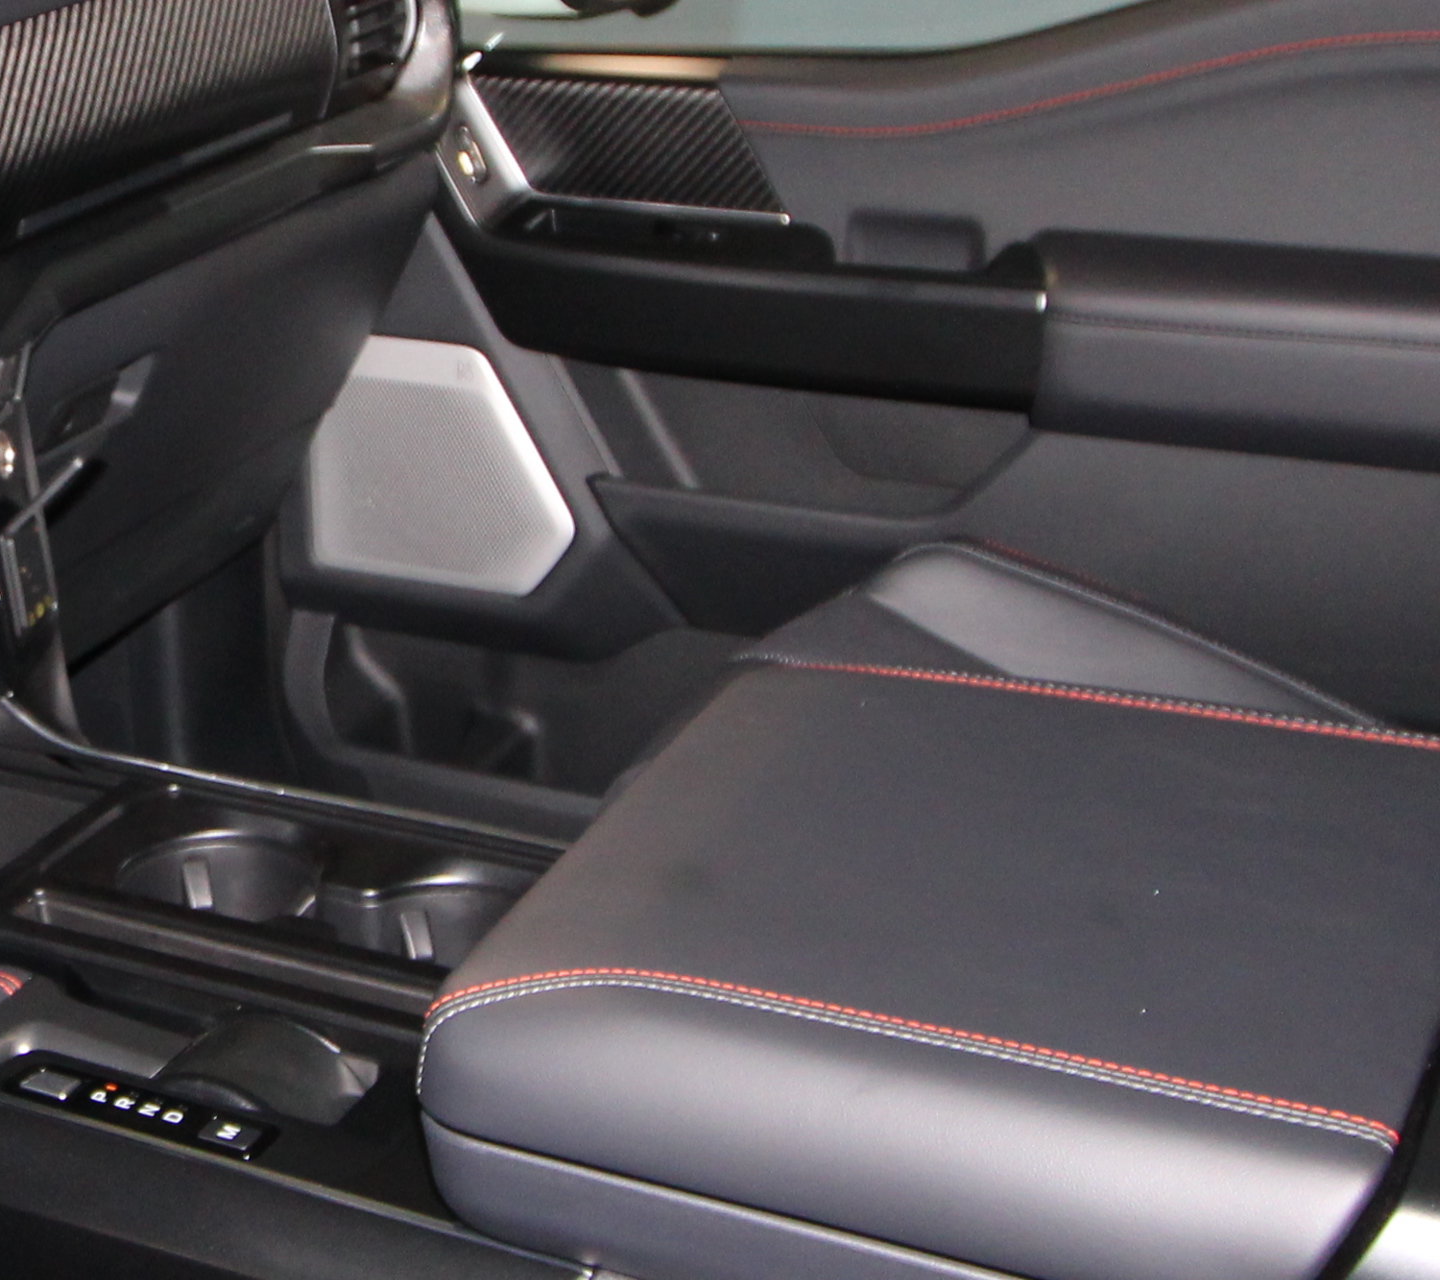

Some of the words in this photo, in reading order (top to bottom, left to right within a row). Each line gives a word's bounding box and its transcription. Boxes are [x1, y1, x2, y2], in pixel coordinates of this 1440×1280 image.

[90, 1090, 107, 1104] P
[114, 1096, 136, 1110] R
[138, 1103, 161, 1117] N
[163, 1110, 184, 1124] D
[217, 1124, 241, 1140] M
